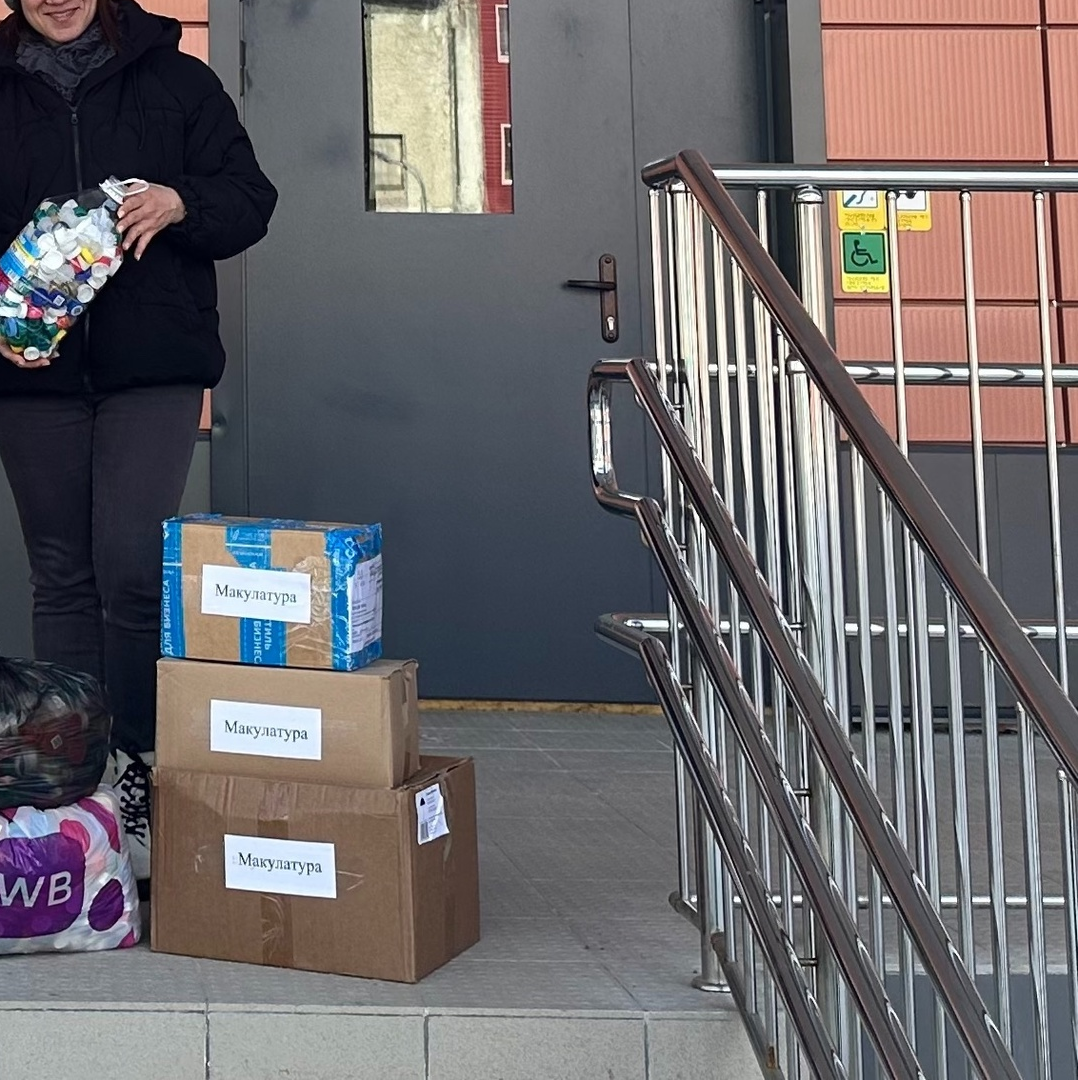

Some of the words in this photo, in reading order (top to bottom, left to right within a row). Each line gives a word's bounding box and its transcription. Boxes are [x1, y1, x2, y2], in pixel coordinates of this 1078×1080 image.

[215, 583, 297, 606] Макулатура
[224, 719, 308, 742] Макулатура
[238, 852, 322, 875] Макулатура
